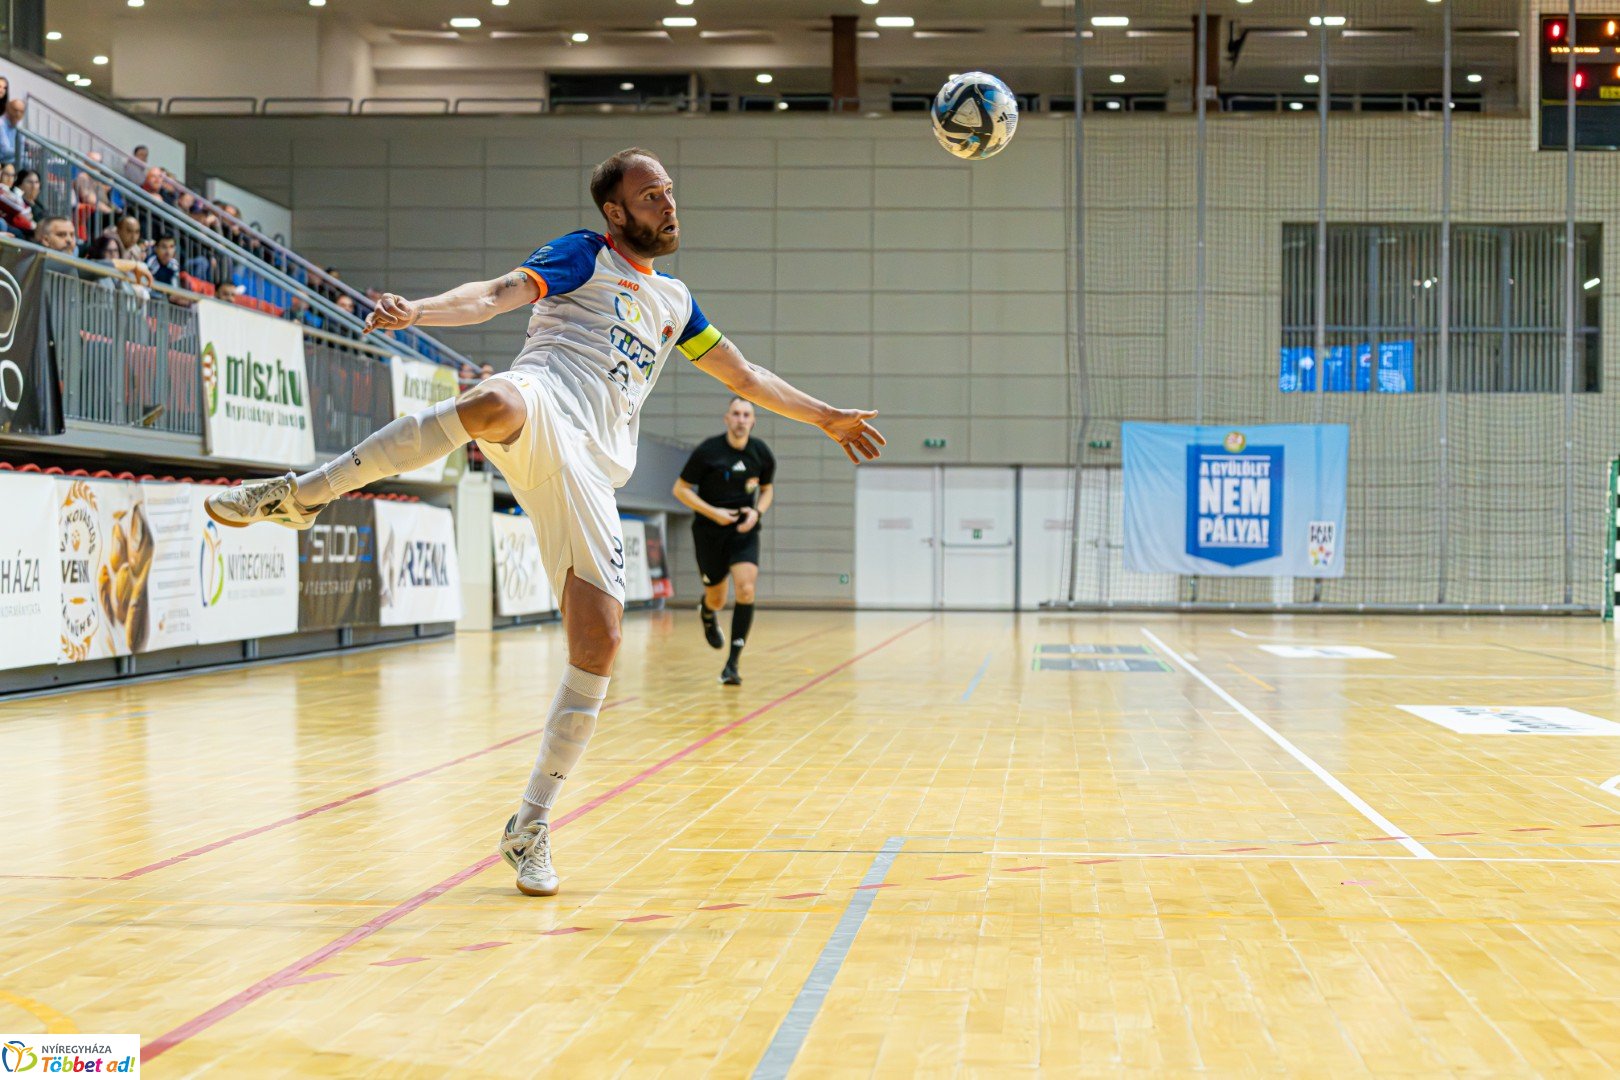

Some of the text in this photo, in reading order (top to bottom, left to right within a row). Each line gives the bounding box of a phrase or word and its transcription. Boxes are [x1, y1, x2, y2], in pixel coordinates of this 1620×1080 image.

[617, 279, 640, 292] JAKO
[226, 351, 303, 407] mlsz.hu
[1201, 462, 1210, 476] A
[1199, 478, 1271, 515] NEM
[1199, 514, 1269, 543] PÁLYA!
[1310, 525, 1333, 534] FAIR
[1310, 535, 1333, 544] PLAY
[228, 546, 286, 581] NYÍREGYHÁZA
[610, 535, 624, 569] 3
